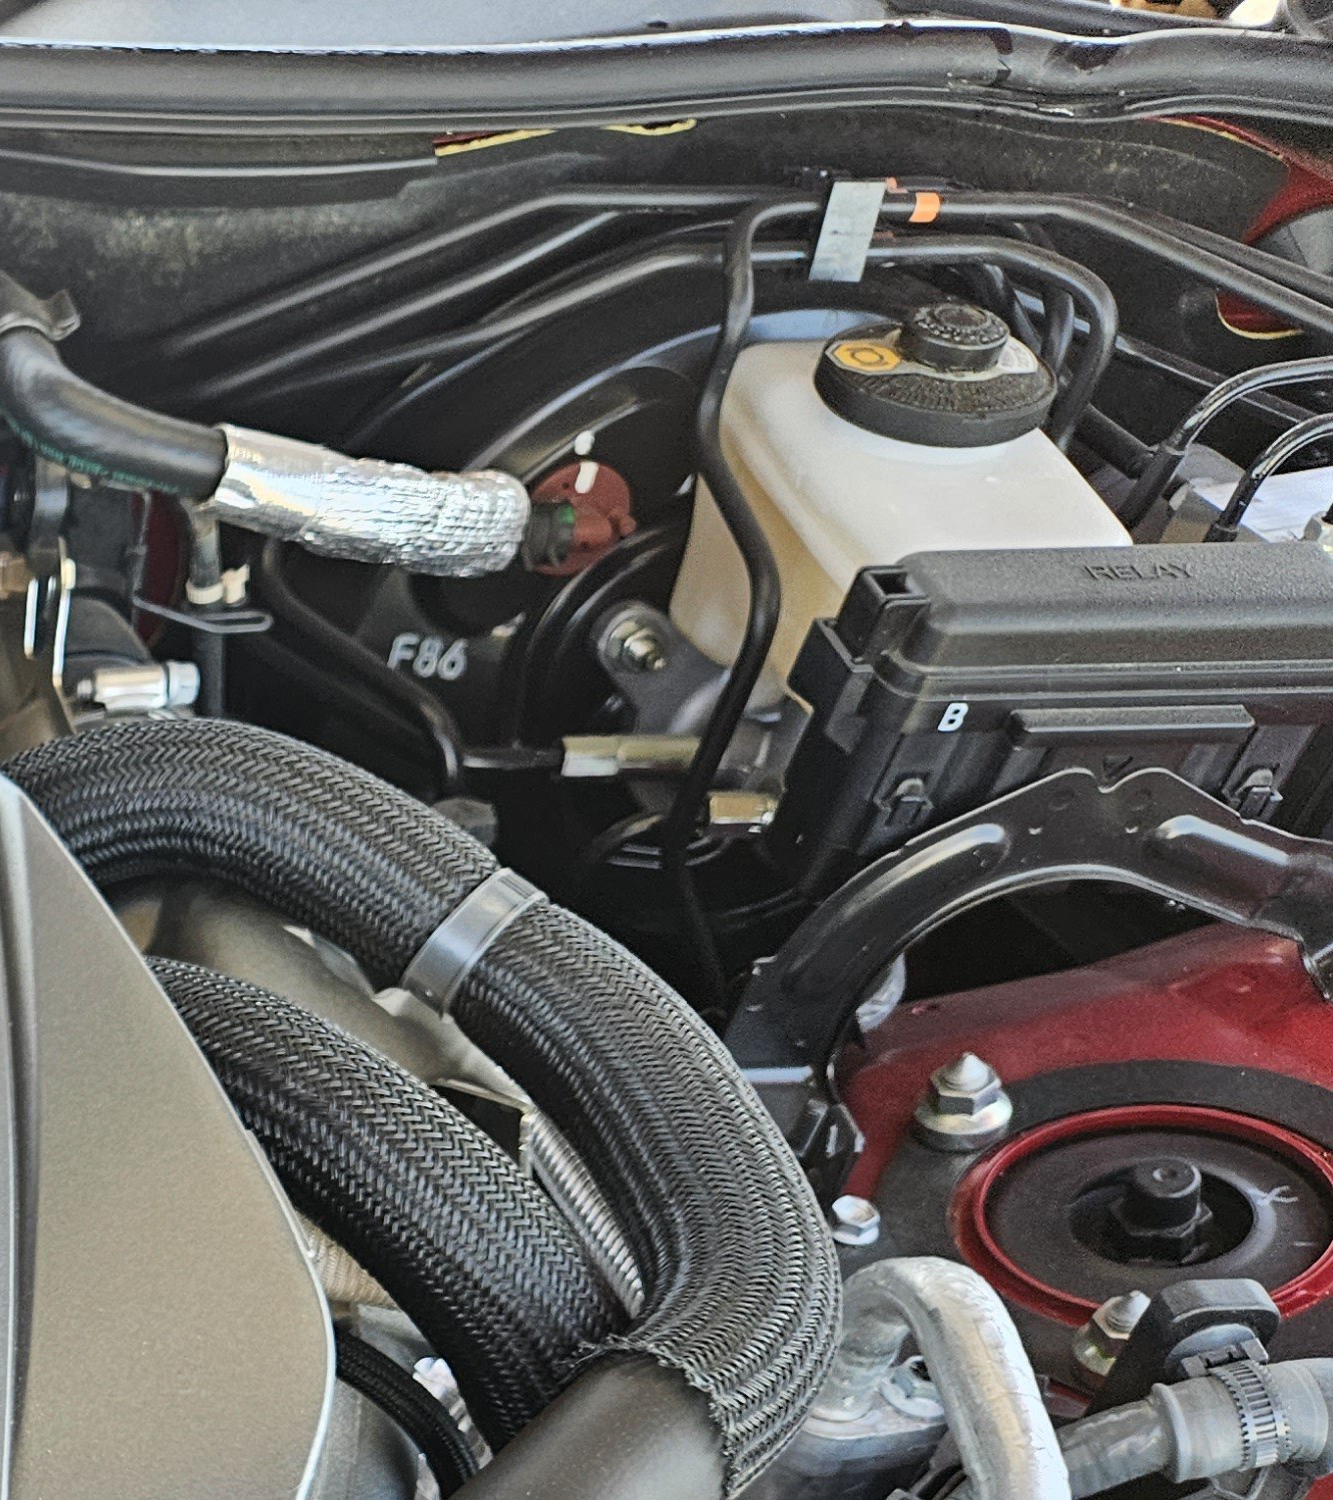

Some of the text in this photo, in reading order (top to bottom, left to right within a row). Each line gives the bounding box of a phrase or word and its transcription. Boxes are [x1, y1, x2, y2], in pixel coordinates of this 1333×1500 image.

[1083, 561, 1194, 582] RELAY
[387, 632, 469, 681] F86
[937, 702, 969, 732] B
